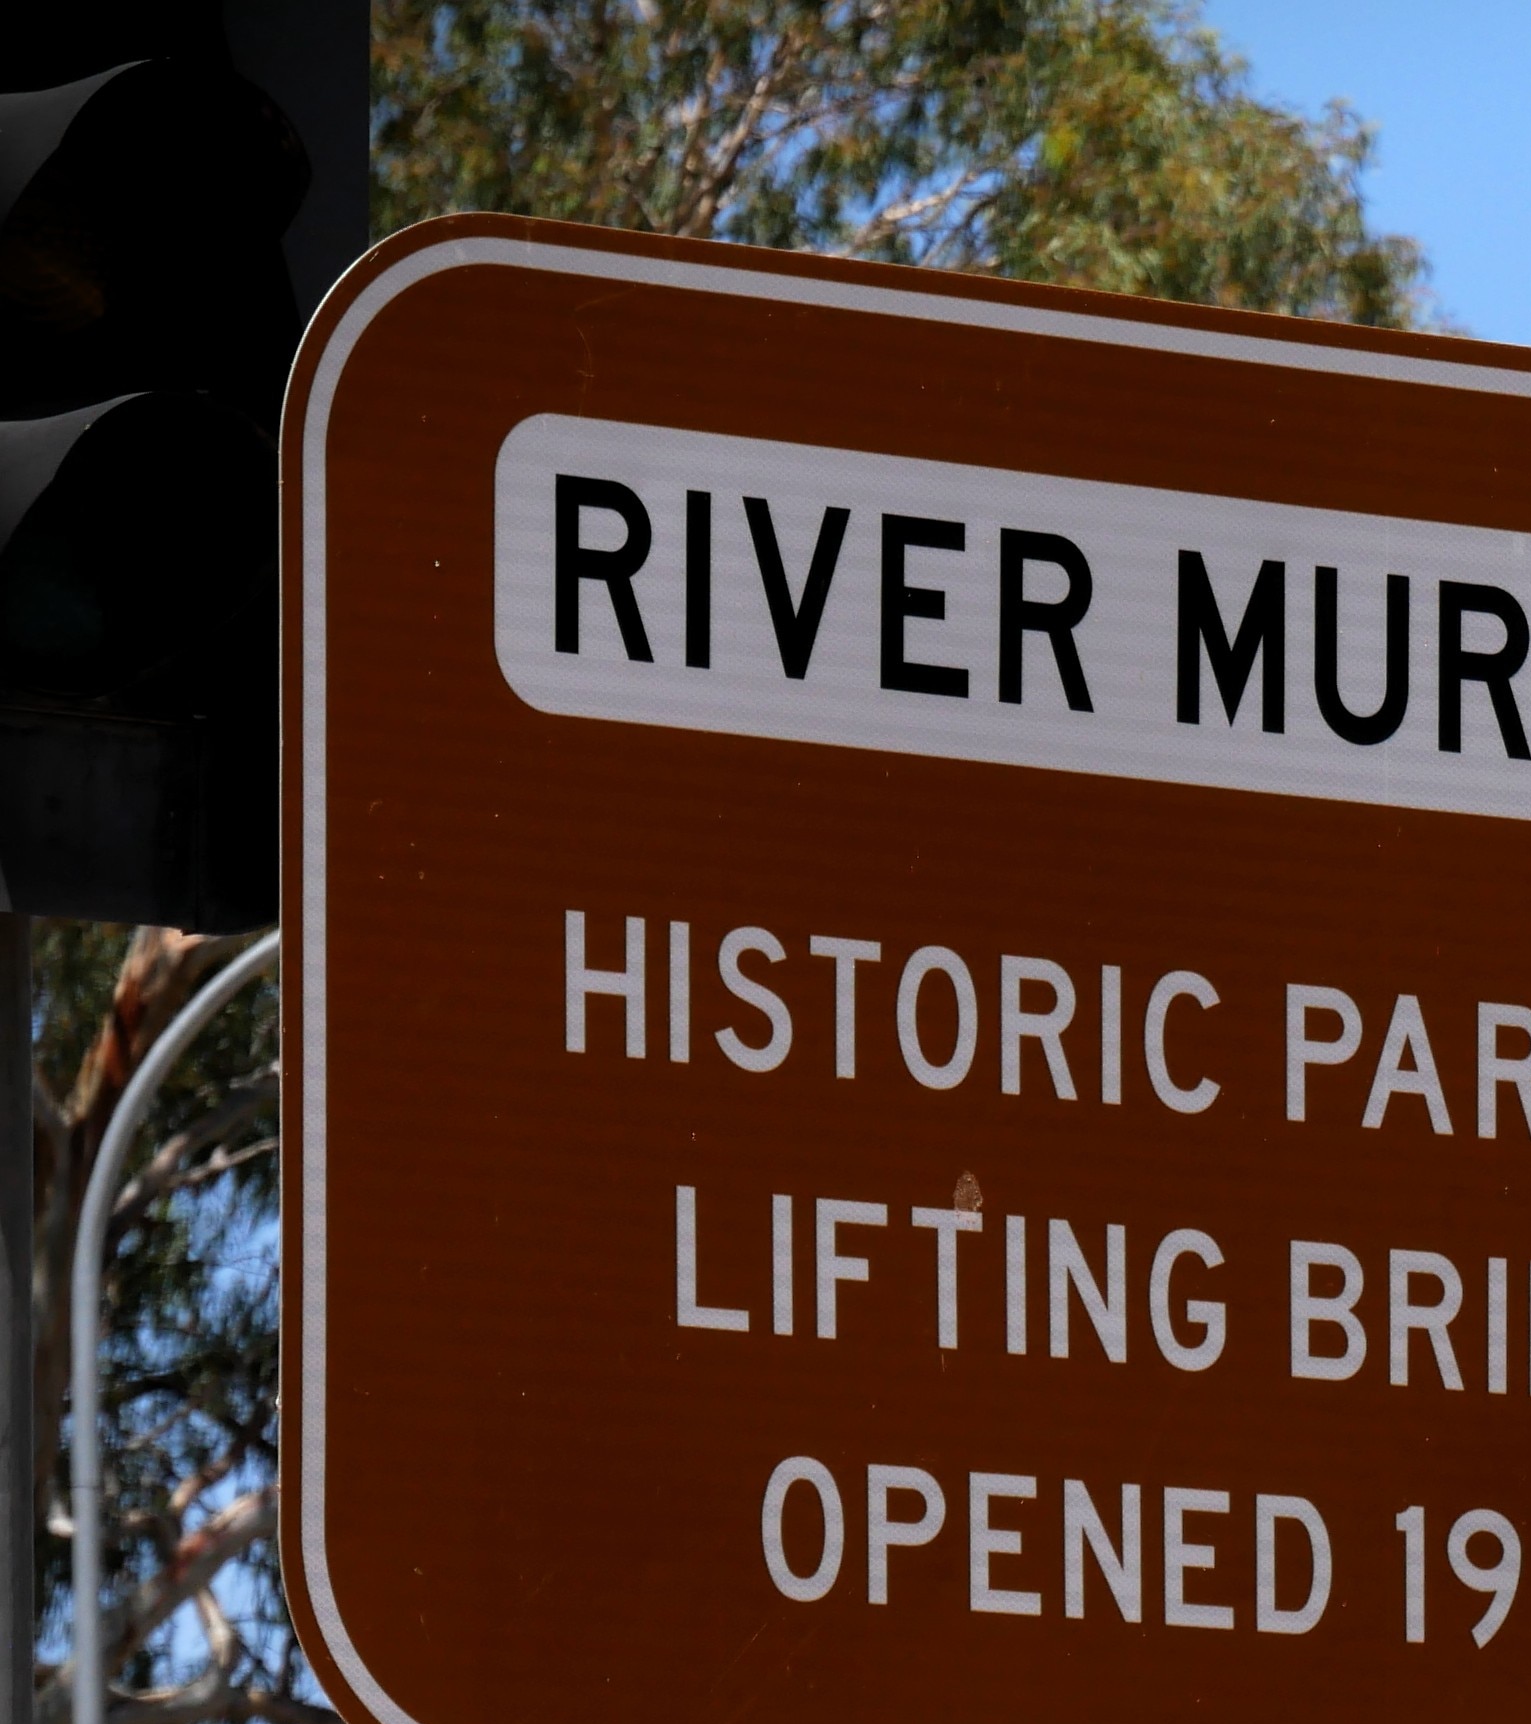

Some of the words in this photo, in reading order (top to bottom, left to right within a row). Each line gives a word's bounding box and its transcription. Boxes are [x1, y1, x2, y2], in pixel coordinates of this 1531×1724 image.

[555, 474, 1094, 713] RIVER
[566, 911, 1220, 1112] HISTORIC
[677, 1186, 1225, 1371] LIFTING
[762, 1457, 1331, 1633] OPENED
